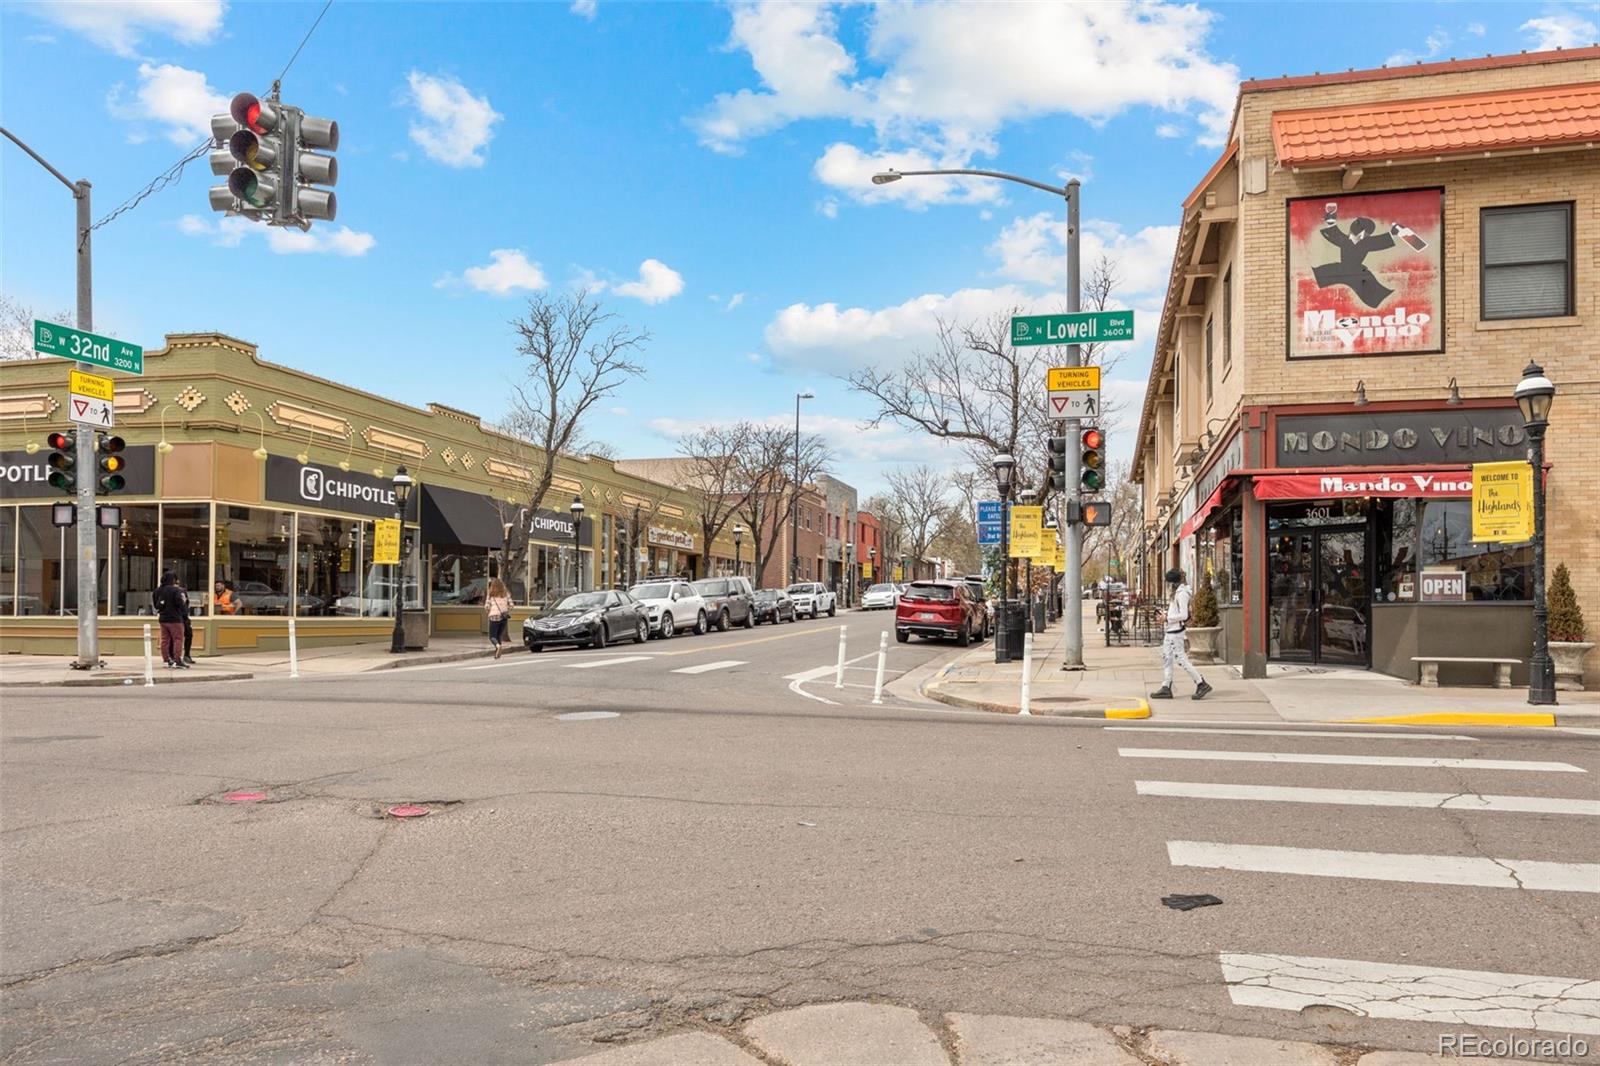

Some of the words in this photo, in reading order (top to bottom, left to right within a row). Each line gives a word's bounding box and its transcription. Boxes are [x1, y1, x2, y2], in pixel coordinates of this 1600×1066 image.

[1303, 307, 1430, 331] Mondo
[1036, 327, 1042, 335] N
[1047, 318, 1097, 340] Lowell
[1110, 318, 1125, 327] Blvd
[1103, 328, 1124, 337] 3600
[1125, 327, 1132, 335] W
[1330, 325, 1422, 350] Vino
[58, 336, 66, 347] W
[70, 334, 110, 362] 32nd
[121, 346, 134, 358] Ave
[114, 356, 132, 369] 3200
[134, 361, 140, 371] N
[80, 376, 105, 388] TURNING
[1059, 371, 1089, 379] TURNING
[78, 385, 106, 397] VEHICLES
[1056, 380, 1091, 388] VEHICLES
[90, 406, 98, 416] TO
[1283, 428, 1418, 452] MONDO
[1430, 424, 1526, 448] VINO
[1320, 476, 1407, 493] Mondo
[1412, 475, 1473, 492] Vino
[1480, 473, 1509, 482] WELCOME
[1511, 473, 1519, 481] TO
[325, 480, 396, 505] CHIPOTLE
[1305, 507, 1330, 519] 3601
[1478, 499, 1522, 514] Highlands
[534, 516, 574, 533] CHIPOTLE
[1423, 578, 1462, 595] OPEN
